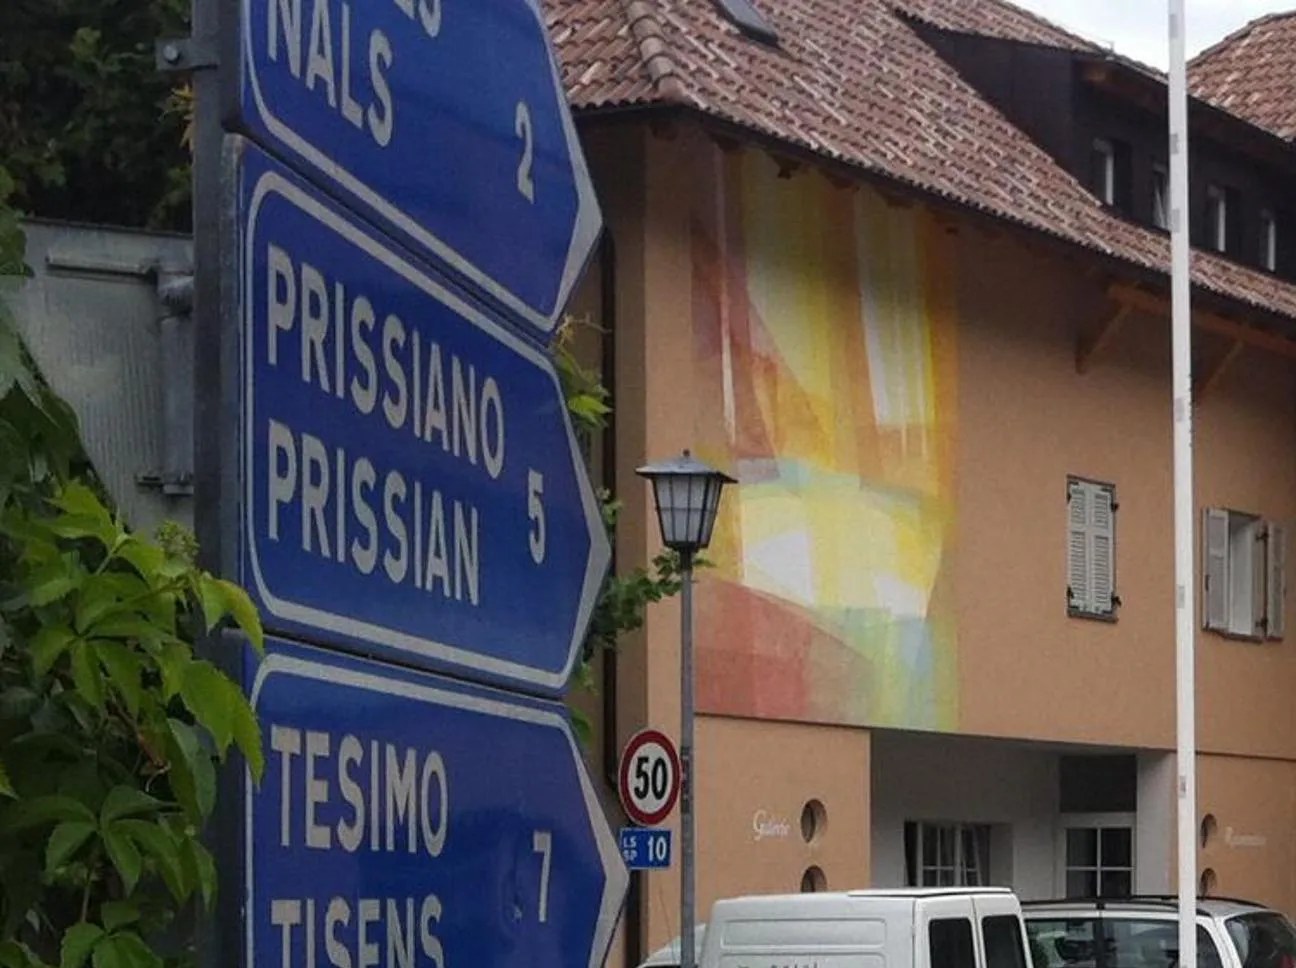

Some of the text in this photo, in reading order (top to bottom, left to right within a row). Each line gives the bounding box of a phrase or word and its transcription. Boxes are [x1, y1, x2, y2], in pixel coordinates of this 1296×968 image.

[268, 0, 393, 147] NALS
[515, 101, 534, 204] 2
[267, 242, 504, 480] PRISSIANO
[267, 418, 480, 607] PRISSIAN
[527, 468, 546, 565] 5
[270, 725, 449, 858] TESIMO
[634, 756, 668, 800] 50
[533, 831, 552, 922] 7
[623, 836, 667, 861] LS 10
